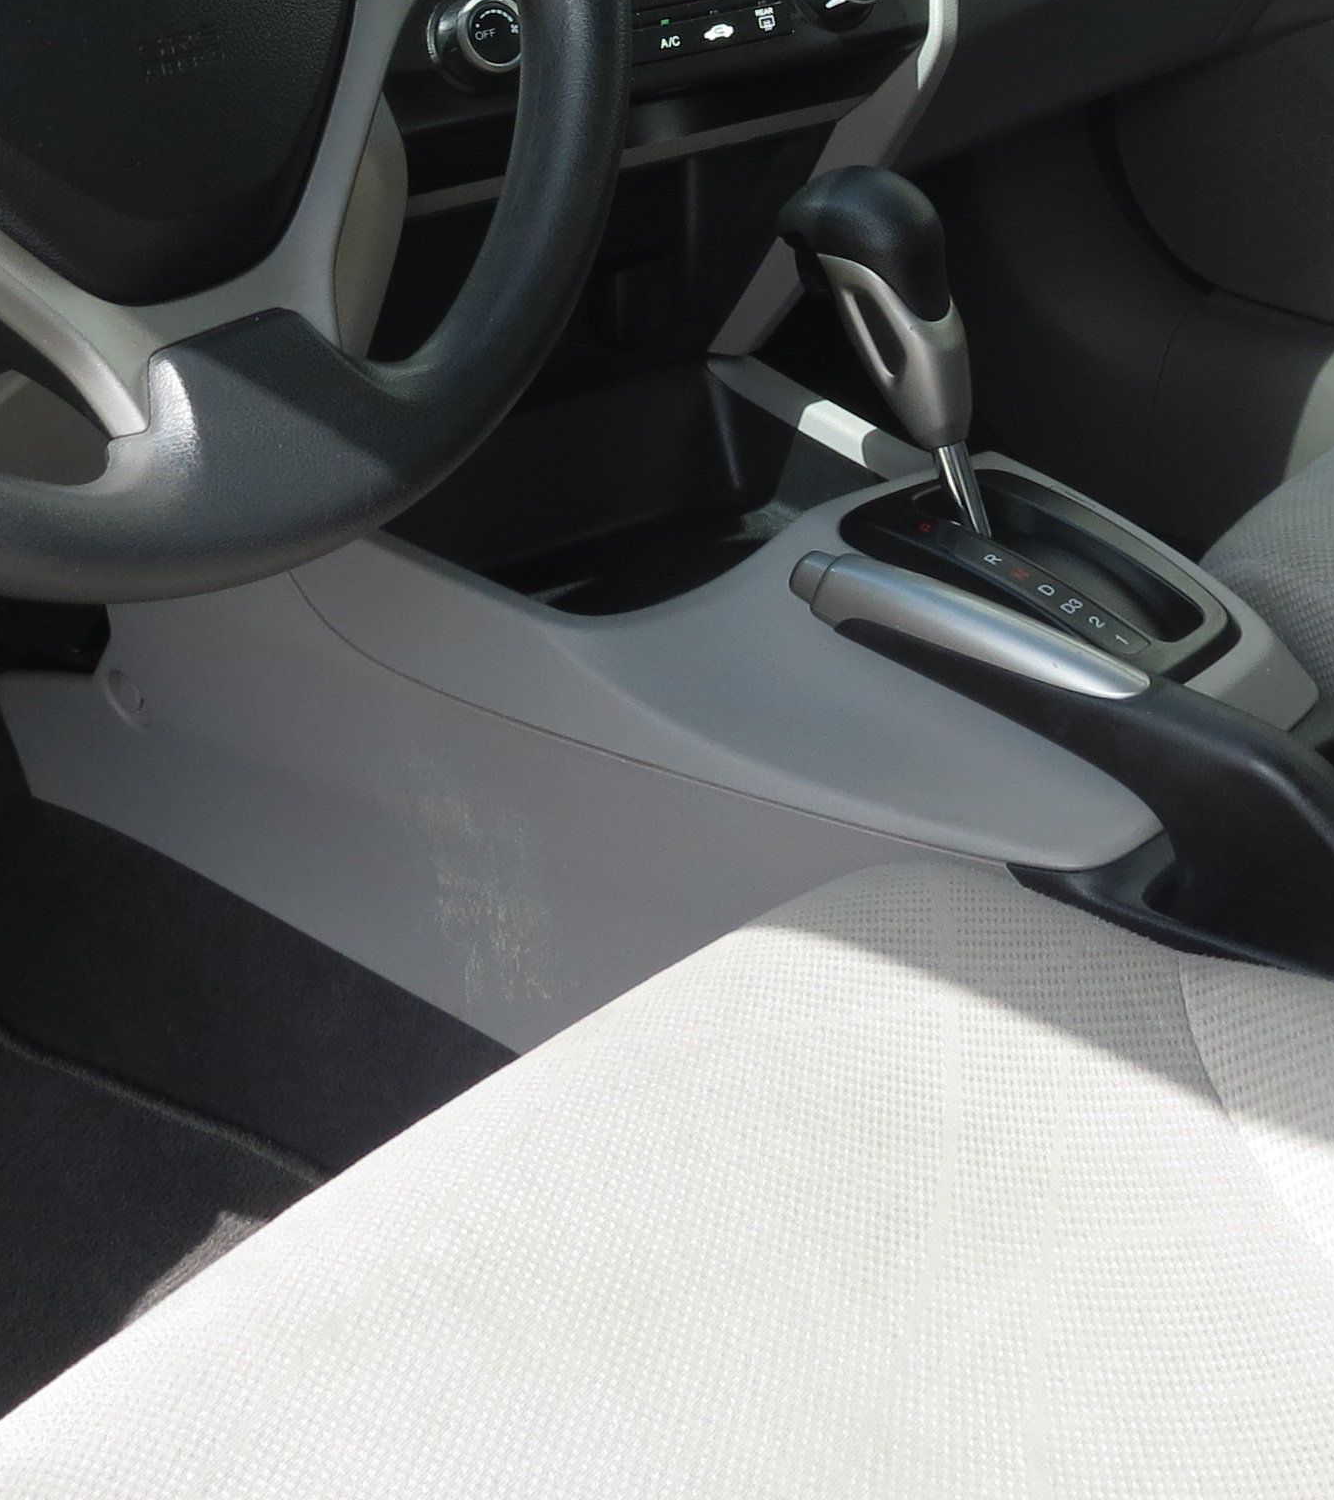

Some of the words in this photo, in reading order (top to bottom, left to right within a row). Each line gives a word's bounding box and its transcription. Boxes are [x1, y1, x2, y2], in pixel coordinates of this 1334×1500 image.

[754, 6, 774, 17] REAR
[475, 28, 496, 41] OFF
[660, 35, 681, 49] A/C
